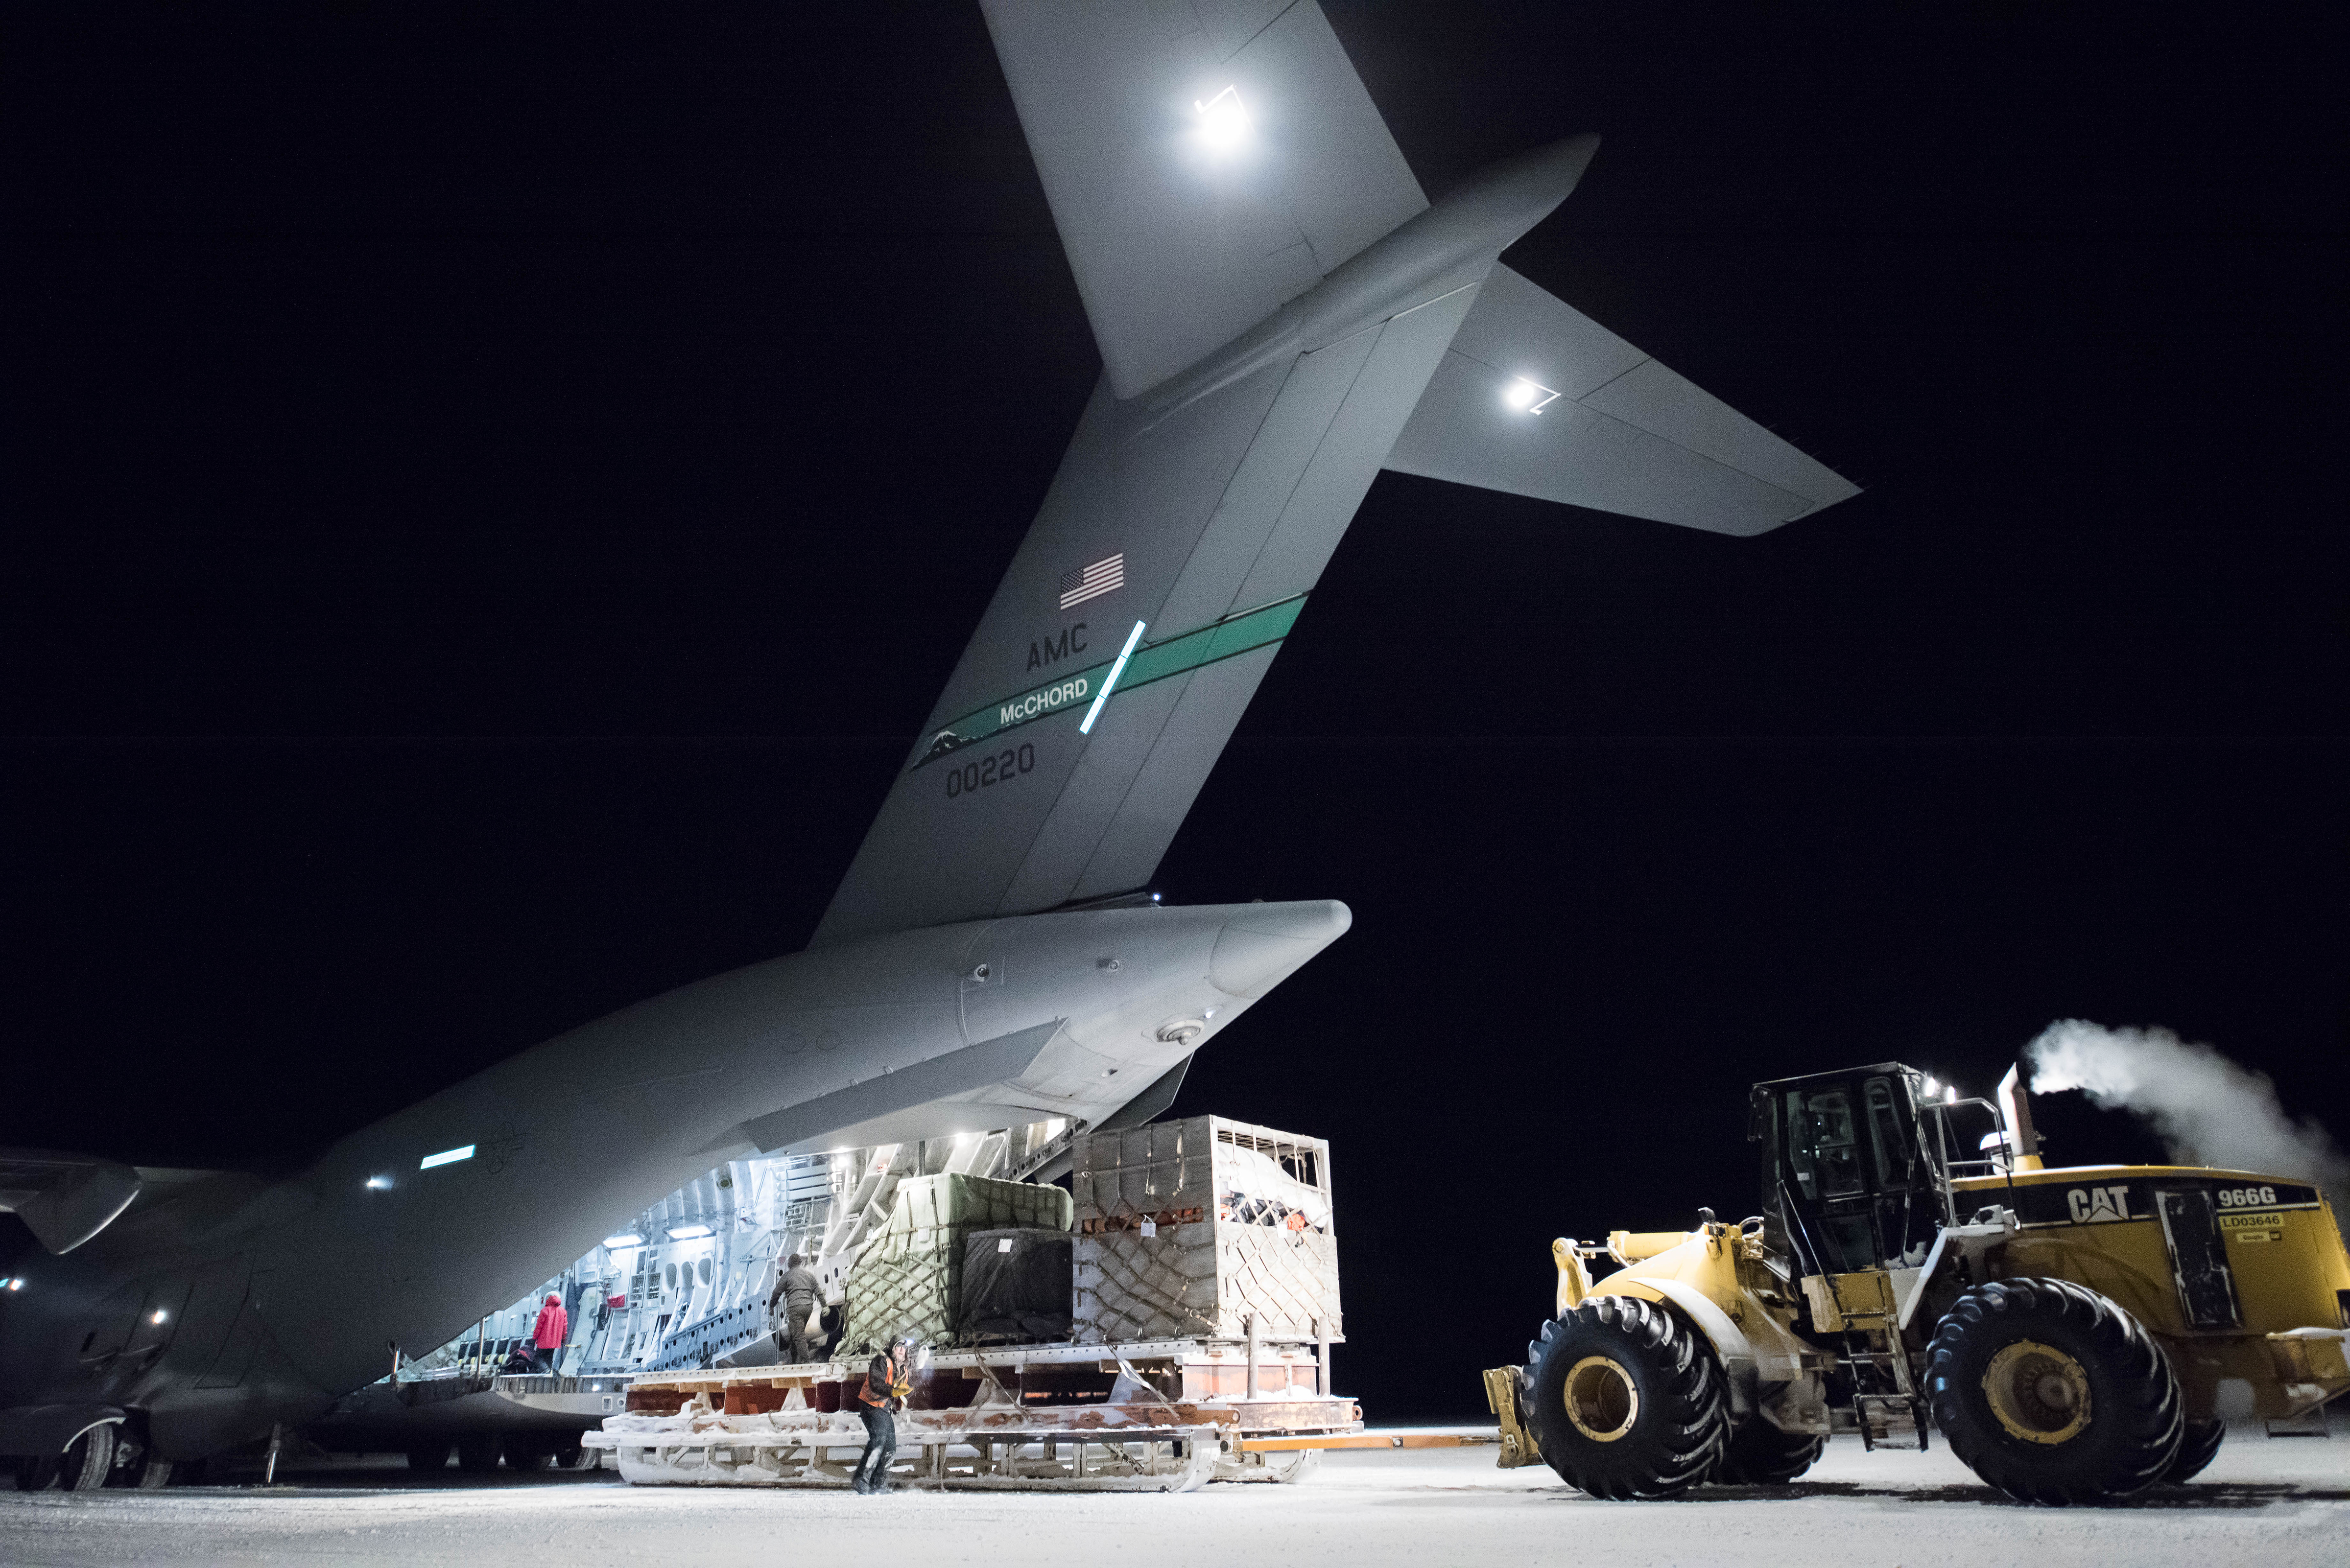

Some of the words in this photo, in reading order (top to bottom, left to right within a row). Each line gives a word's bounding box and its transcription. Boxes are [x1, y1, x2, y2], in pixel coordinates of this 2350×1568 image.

[1026, 623, 1088, 672] AMC
[1000, 679, 1088, 724] McCHORD
[947, 743, 1034, 799] 00220
[2067, 1186, 2129, 1222] CAT
[2218, 1187, 2277, 1207] 966G
[2222, 1215, 2280, 1227] LD03646
